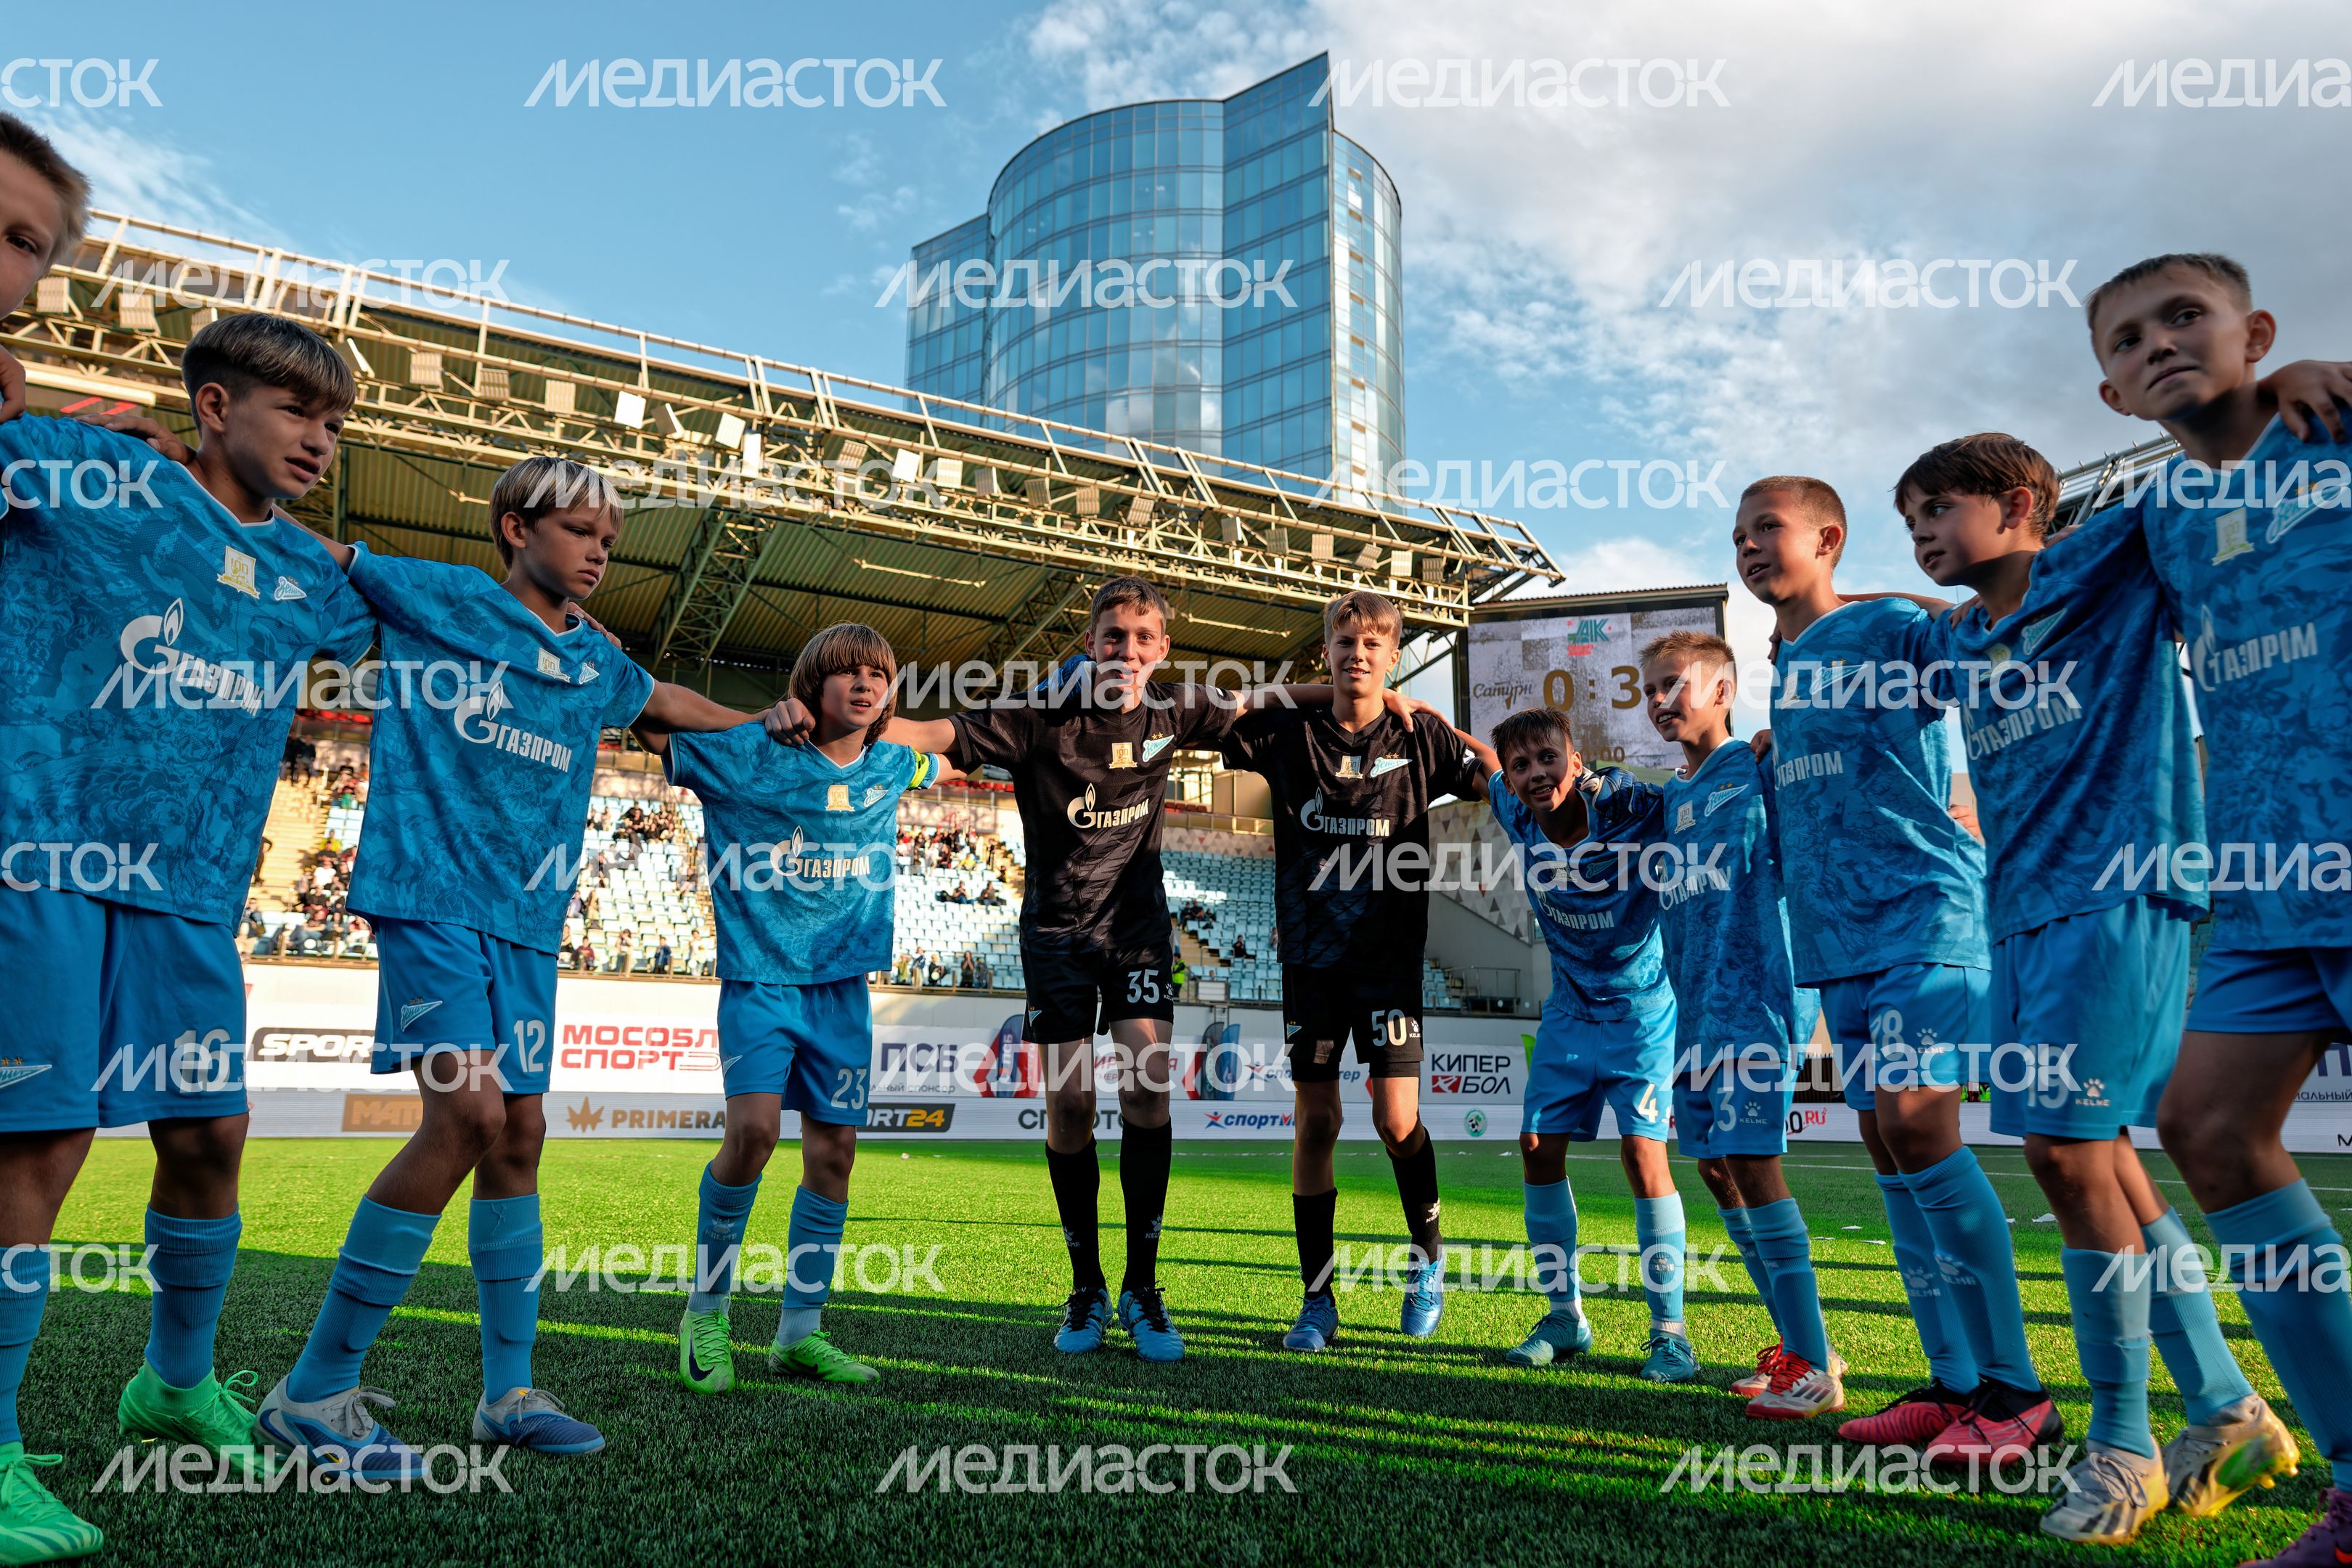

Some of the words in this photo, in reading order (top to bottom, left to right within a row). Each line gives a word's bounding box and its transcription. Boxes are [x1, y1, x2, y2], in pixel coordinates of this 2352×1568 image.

[176, 653, 264, 717] ГАЗПРОМ
[1543, 669, 1575, 713] 0
[1611, 666, 1642, 709] 3
[496, 726, 572, 773] ГАЗПРОМ
[1097, 798, 1149, 829] ГАЗПРОМ
[1324, 817, 1390, 837] ГАЗПРОМ
[804, 856, 870, 878] ГАЗПРОМ
[1550, 910, 1614, 930] ГАЗПРОМ
[1127, 969, 1160, 1003] 35
[1372, 1009, 1407, 1046] 50
[258, 1033, 375, 1058] SPOR
[514, 1019, 545, 1073] 12
[560, 1048, 685, 1071] СПОРТ
[881, 1042, 959, 1072] ПСБ
[175, 1029, 231, 1093] 16
[1432, 1053, 1511, 1074] КИПЕР
[831, 1068, 867, 1109] 23
[907, 1085, 955, 1095] спонсор
[1461, 1075, 1511, 1094] БОЛ
[351, 1101, 423, 1126] МАТ
[1638, 1083, 1659, 1124] 4
[1716, 1087, 1736, 1132] 3
[2075, 1098, 2111, 1107] KELME
[611, 1109, 726, 1129] PRIMERA
